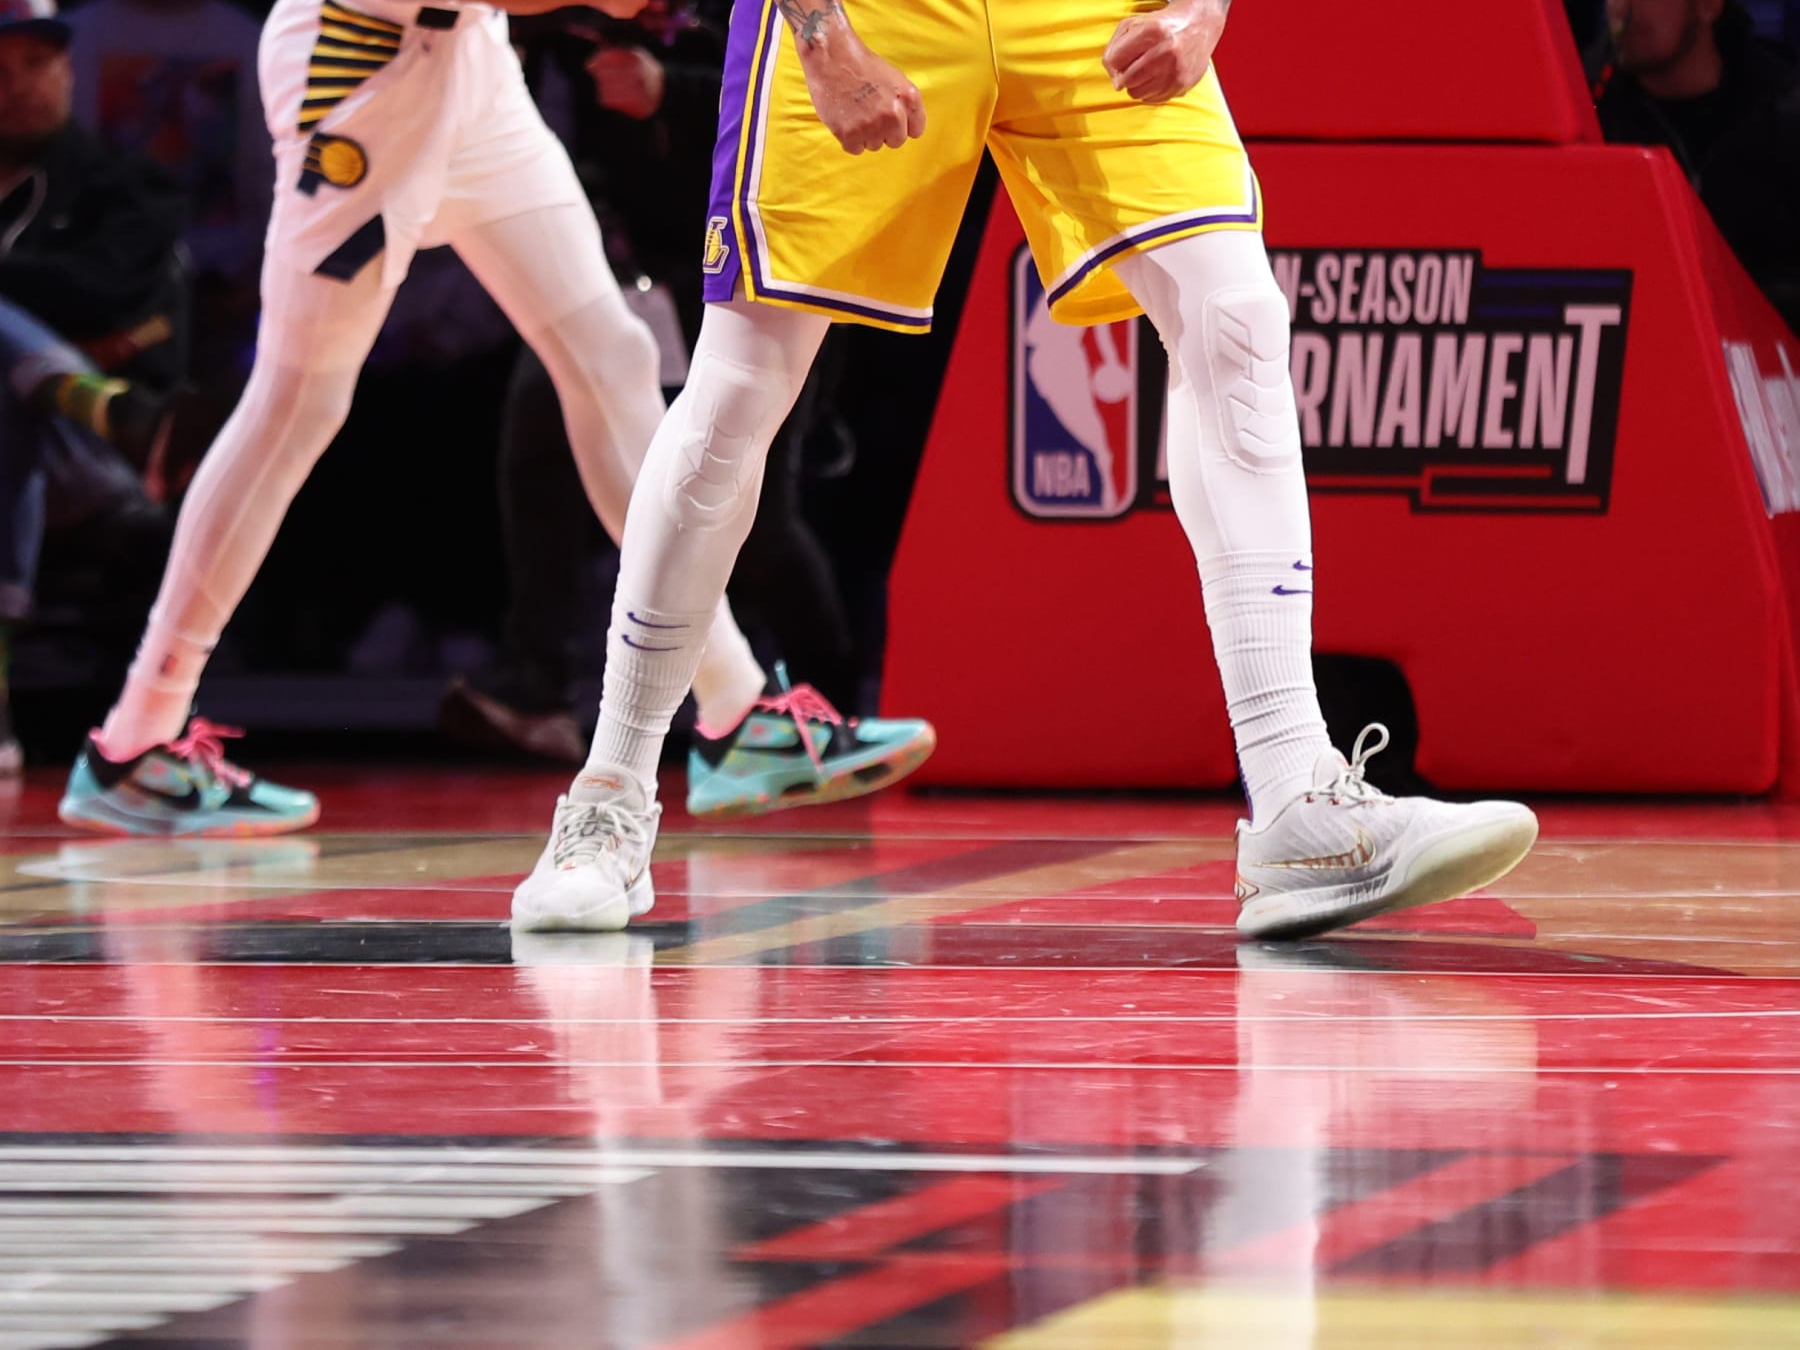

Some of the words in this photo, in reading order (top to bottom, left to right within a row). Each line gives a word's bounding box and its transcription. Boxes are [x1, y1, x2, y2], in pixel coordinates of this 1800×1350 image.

[1270, 253, 1474, 325] N-SEASON
[1155, 305, 1621, 484] RNAMENT
[1033, 451, 1091, 498] NBA
